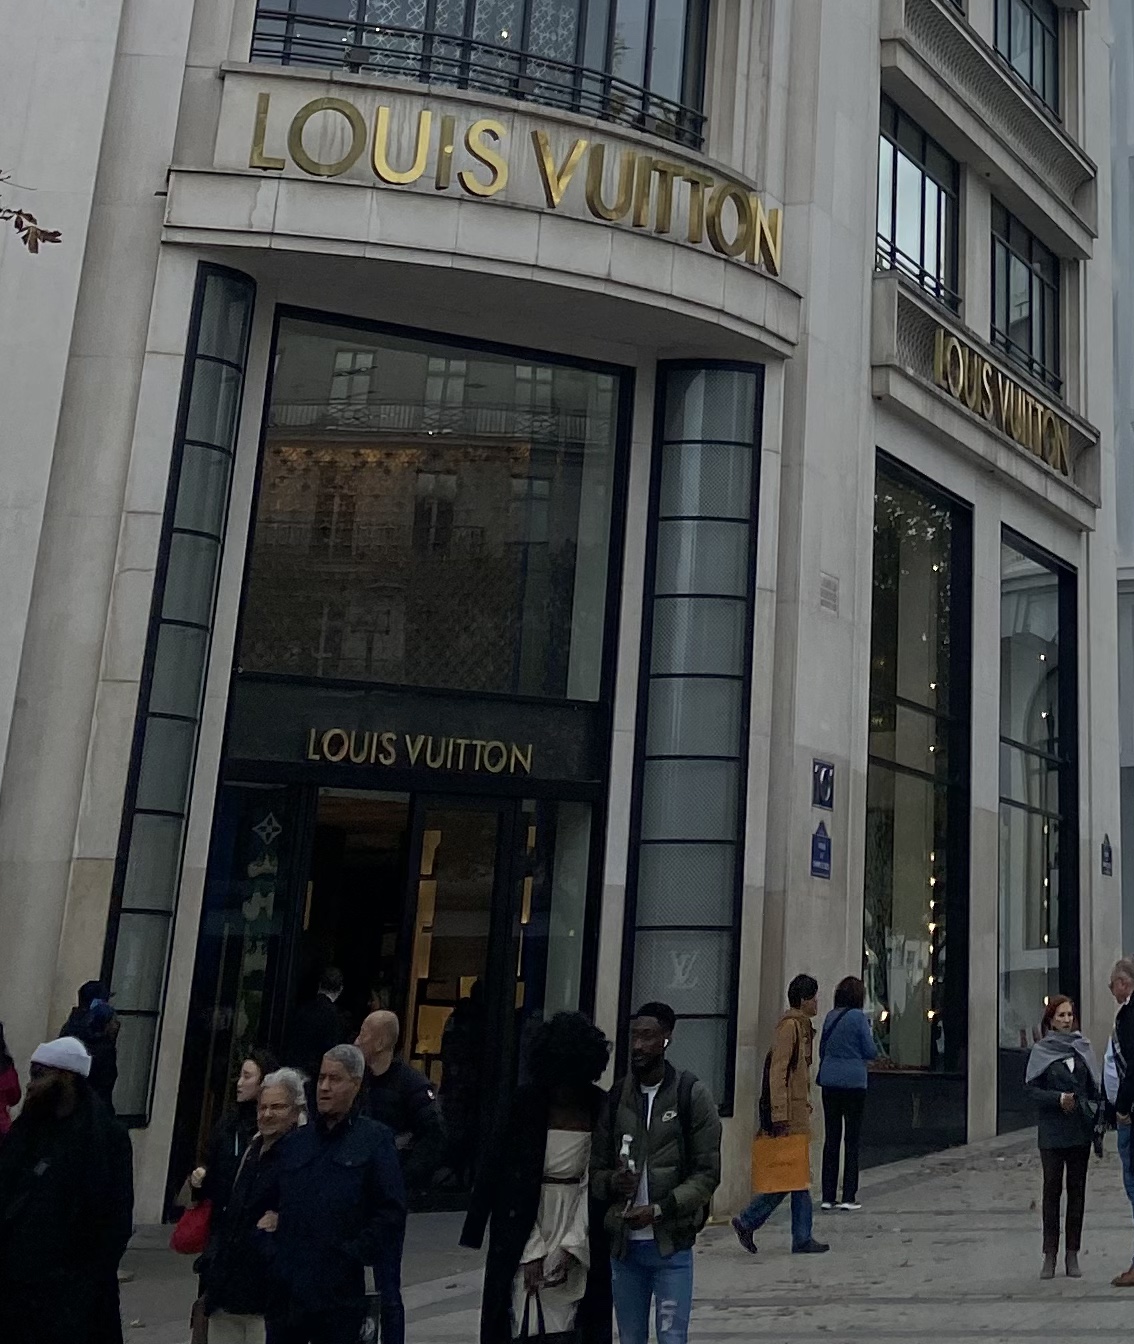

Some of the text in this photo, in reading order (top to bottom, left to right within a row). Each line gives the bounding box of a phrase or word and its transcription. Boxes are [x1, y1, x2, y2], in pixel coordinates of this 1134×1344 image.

[249, 92, 782, 276] LOUIS VUITTON
[997, 372, 1069, 477] VUITTON
[306, 727, 533, 774] LOUIS VUITTON
